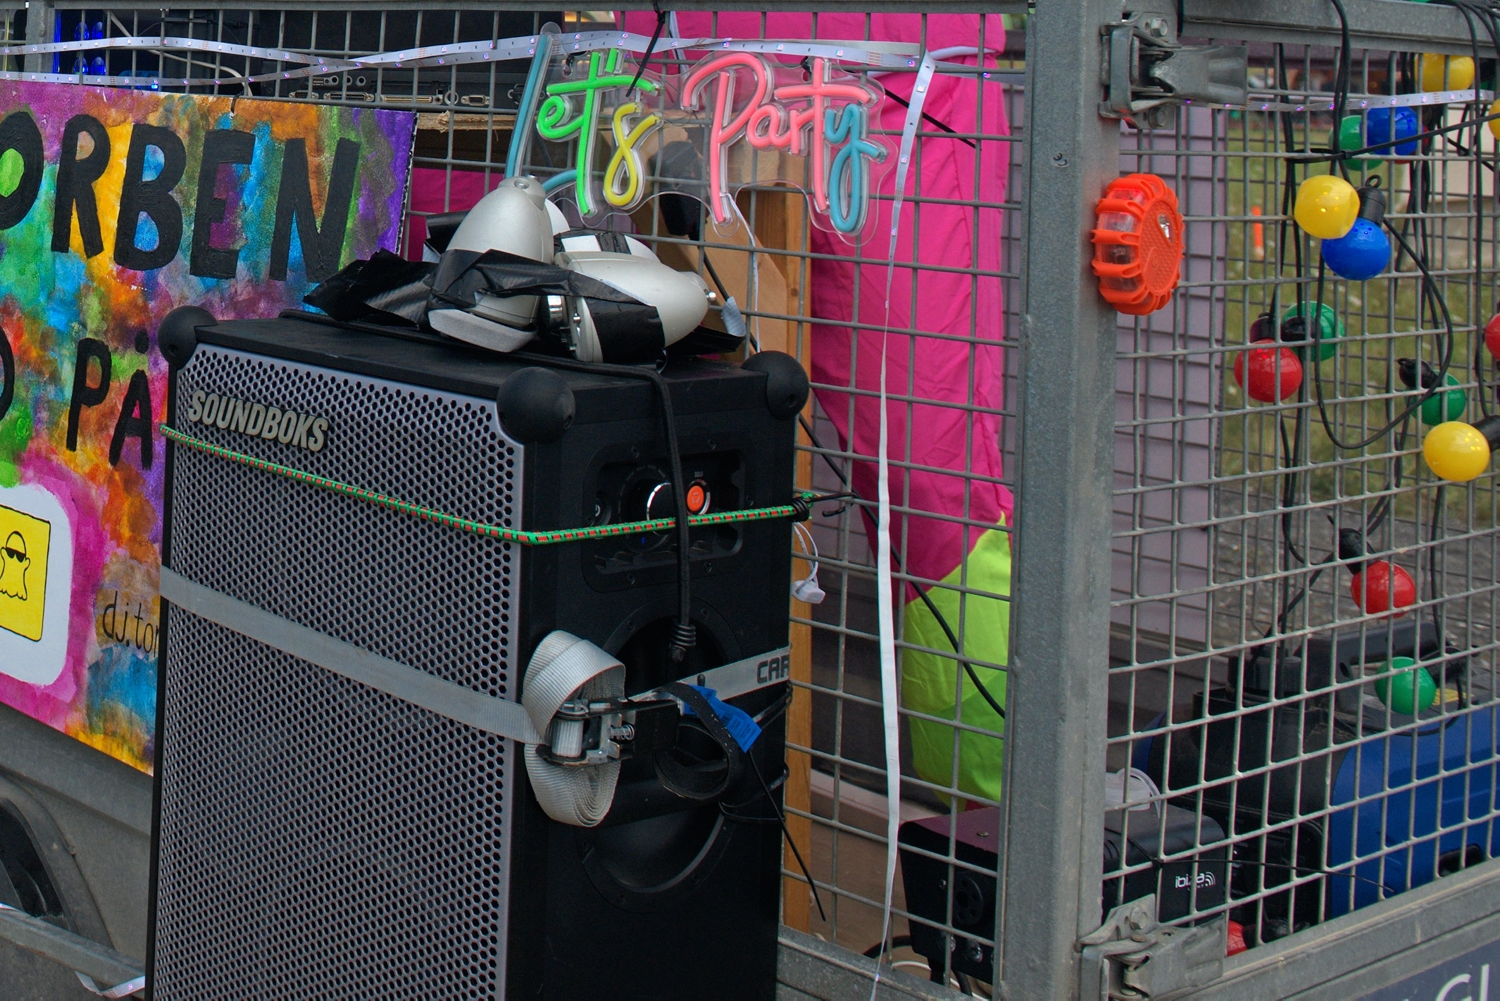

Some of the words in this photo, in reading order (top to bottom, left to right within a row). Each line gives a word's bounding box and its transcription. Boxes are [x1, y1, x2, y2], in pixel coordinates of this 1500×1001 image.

[683, 52, 889, 232] Party
[66, 329, 154, 471] PÅ
[188, 389, 329, 452] SOUNDBOKS
[1175, 872, 1205, 889] ibia
